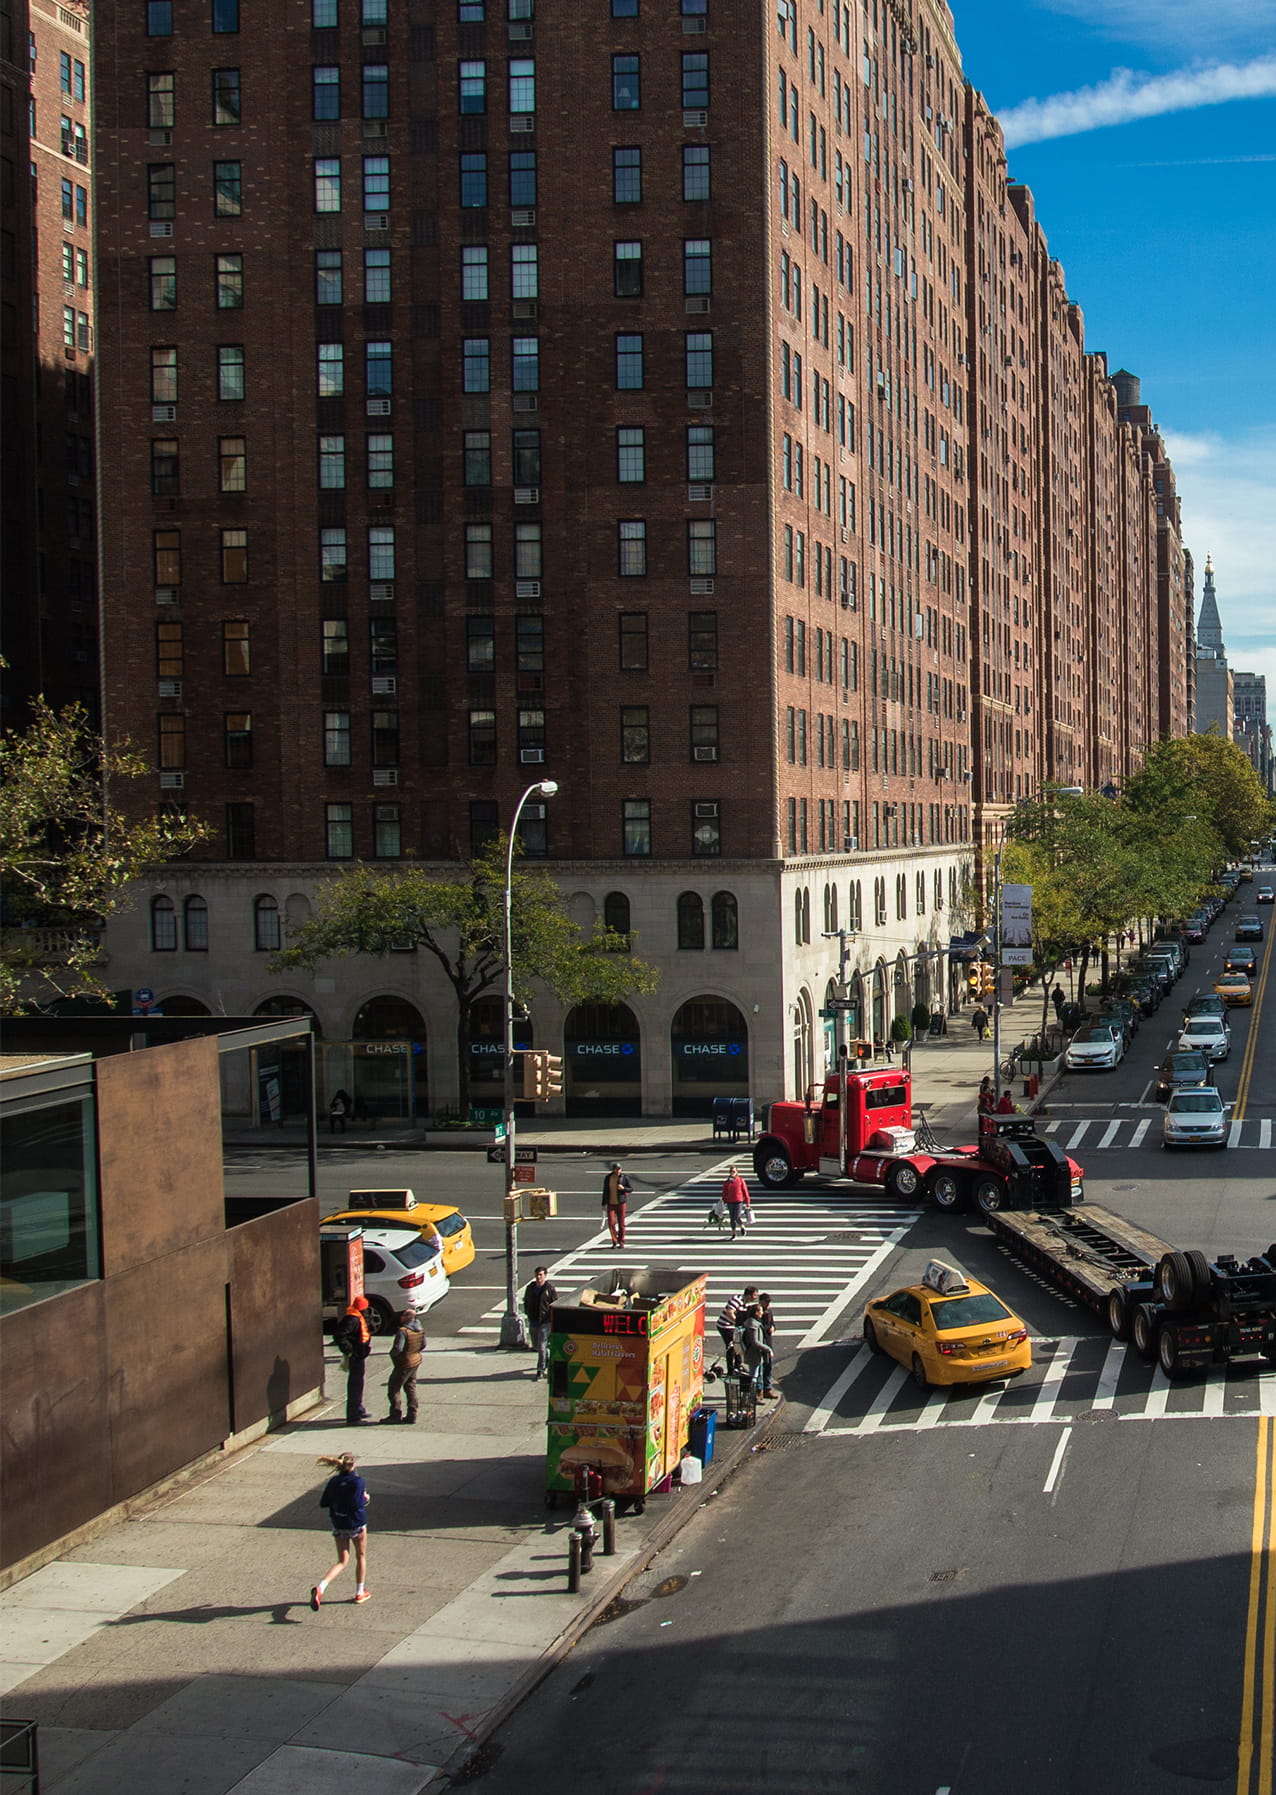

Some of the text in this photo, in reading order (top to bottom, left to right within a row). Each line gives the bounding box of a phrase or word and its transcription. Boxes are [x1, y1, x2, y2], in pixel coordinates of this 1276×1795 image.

[366, 1044, 408, 1054] CHASE
[471, 1044, 506, 1054] CHAS
[577, 1044, 620, 1055] CHASE
[683, 1044, 727, 1055] CHASE
[474, 1110, 486, 1120] 10
